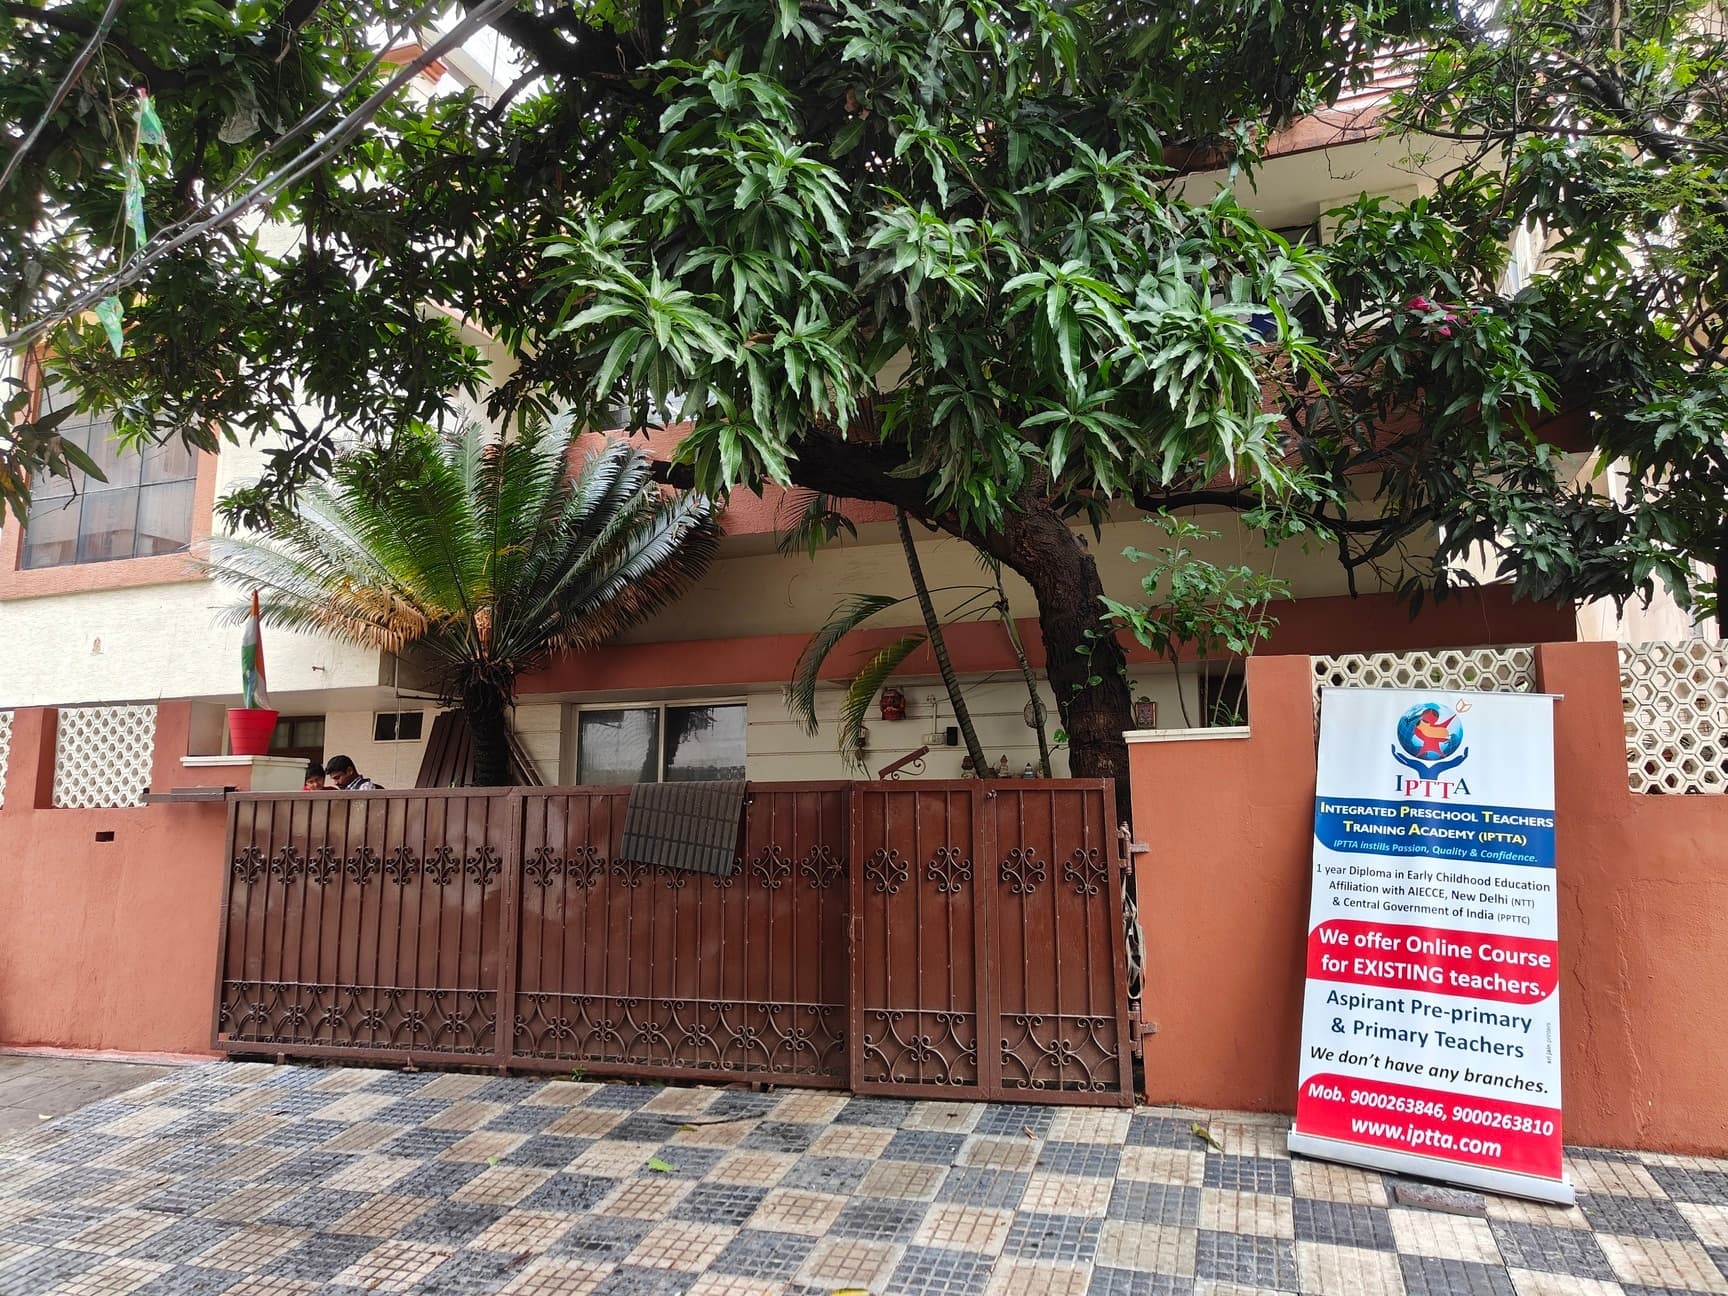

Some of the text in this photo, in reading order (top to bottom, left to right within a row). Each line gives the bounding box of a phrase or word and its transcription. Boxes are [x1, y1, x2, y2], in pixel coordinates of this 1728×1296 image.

[1396, 775, 1471, 799] IPTTA
[1320, 802, 1554, 827] INTEGRATED PRESCHOOL TEACHERS
[1343, 821, 1527, 846] TRAINING ACADEMY (IPTTA)
[1333, 840, 1538, 863] IPTTA instills Passion, Quality & Confidence.
[1317, 864, 1550, 892] 1 year Diploma in Early Childhood Education
[1329, 881, 1535, 908] Affiliation with AIECCE, New Delhi (NTT)
[1332, 897, 1530, 925] & Central Government of India (PPTTC)
[1319, 927, 1551, 968] We offer Online Course
[1321, 954, 1547, 997] for EXISTING teachers.
[1326, 990, 1532, 1033] Aspirant Pre-primary
[1331, 1017, 1524, 1058] & Primary Teachers
[1311, 1046, 1334, 1061] We
[1385, 1055, 1423, 1074] have
[1428, 1066, 1460, 1083] any
[1464, 1067, 1549, 1094] branches.
[1308, 1083, 1554, 1136] Mob. 9000263846, 9000263810
[1351, 1118, 1501, 1158] www.iptta.com
